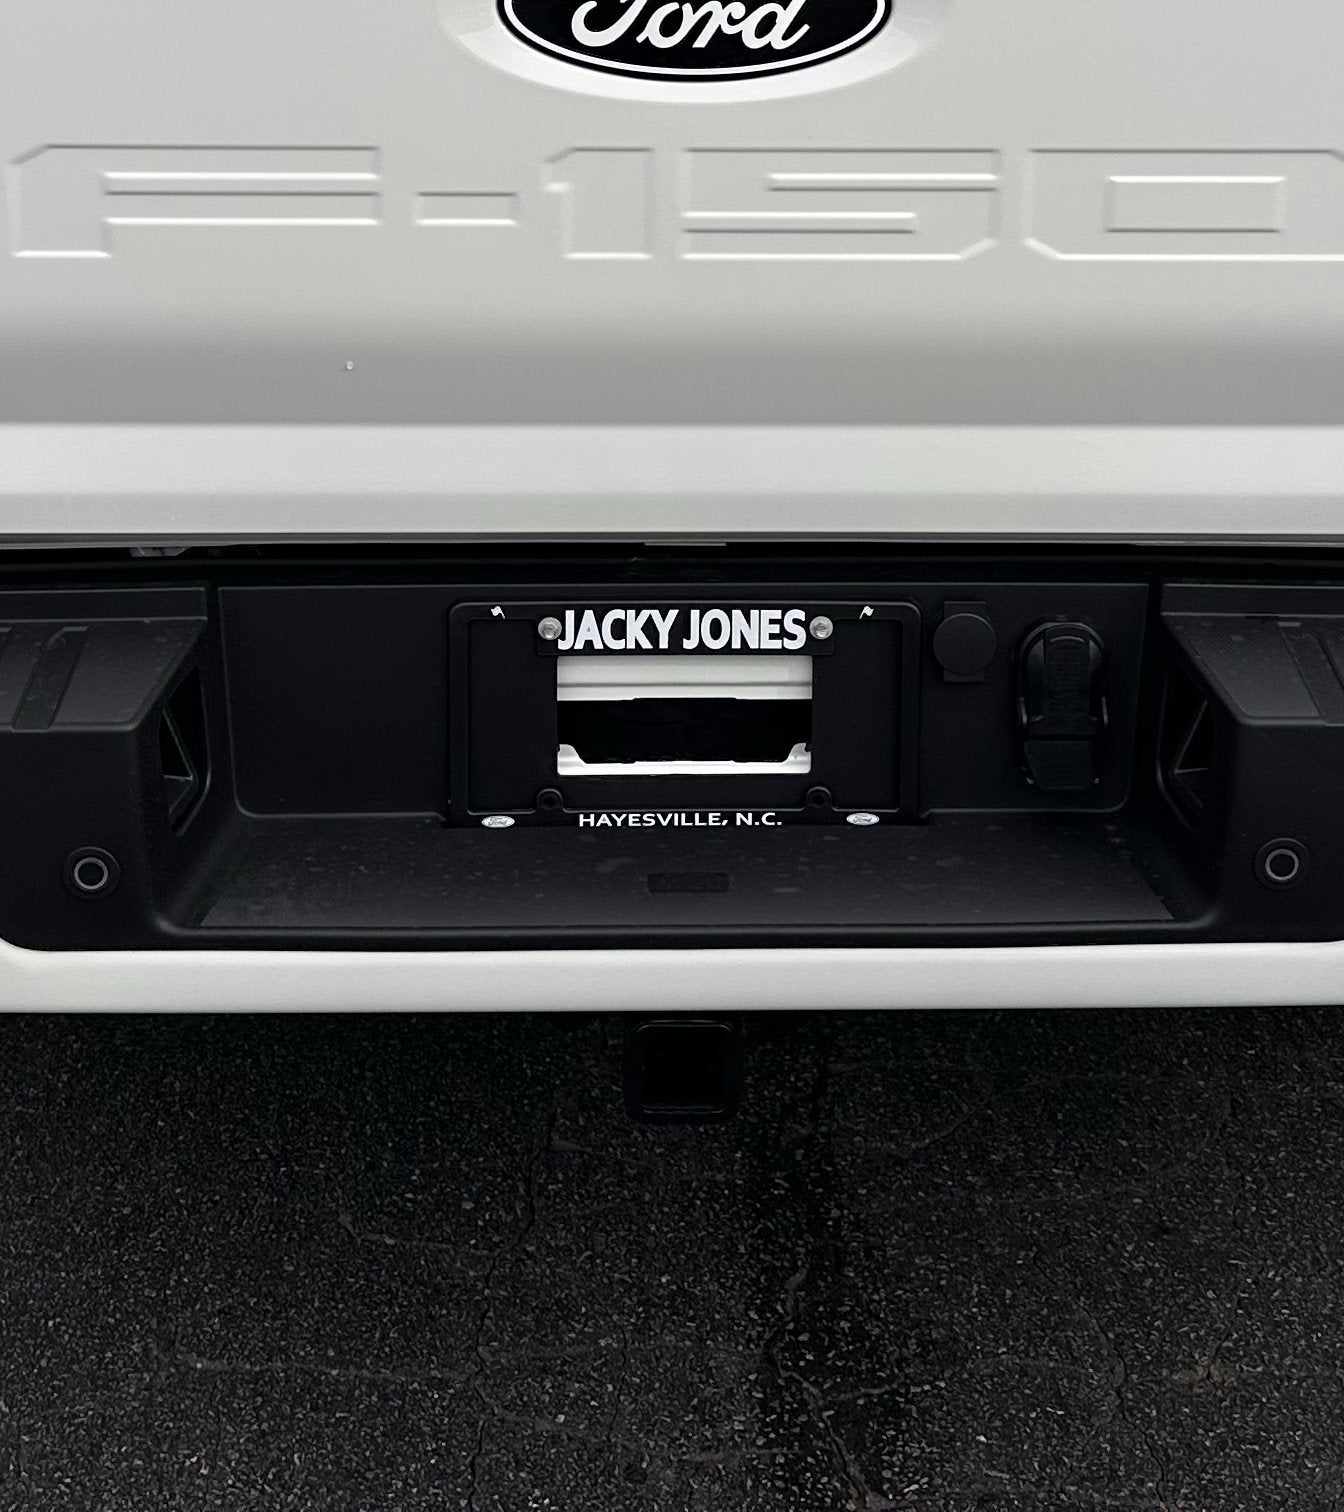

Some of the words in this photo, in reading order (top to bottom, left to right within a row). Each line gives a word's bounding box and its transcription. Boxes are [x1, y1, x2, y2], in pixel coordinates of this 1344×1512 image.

[558, 609, 679, 650] JACKY
[683, 609, 806, 650] JONES
[578, 813, 729, 827] HAYESVILLE,
[735, 812, 782, 826] N.C.
